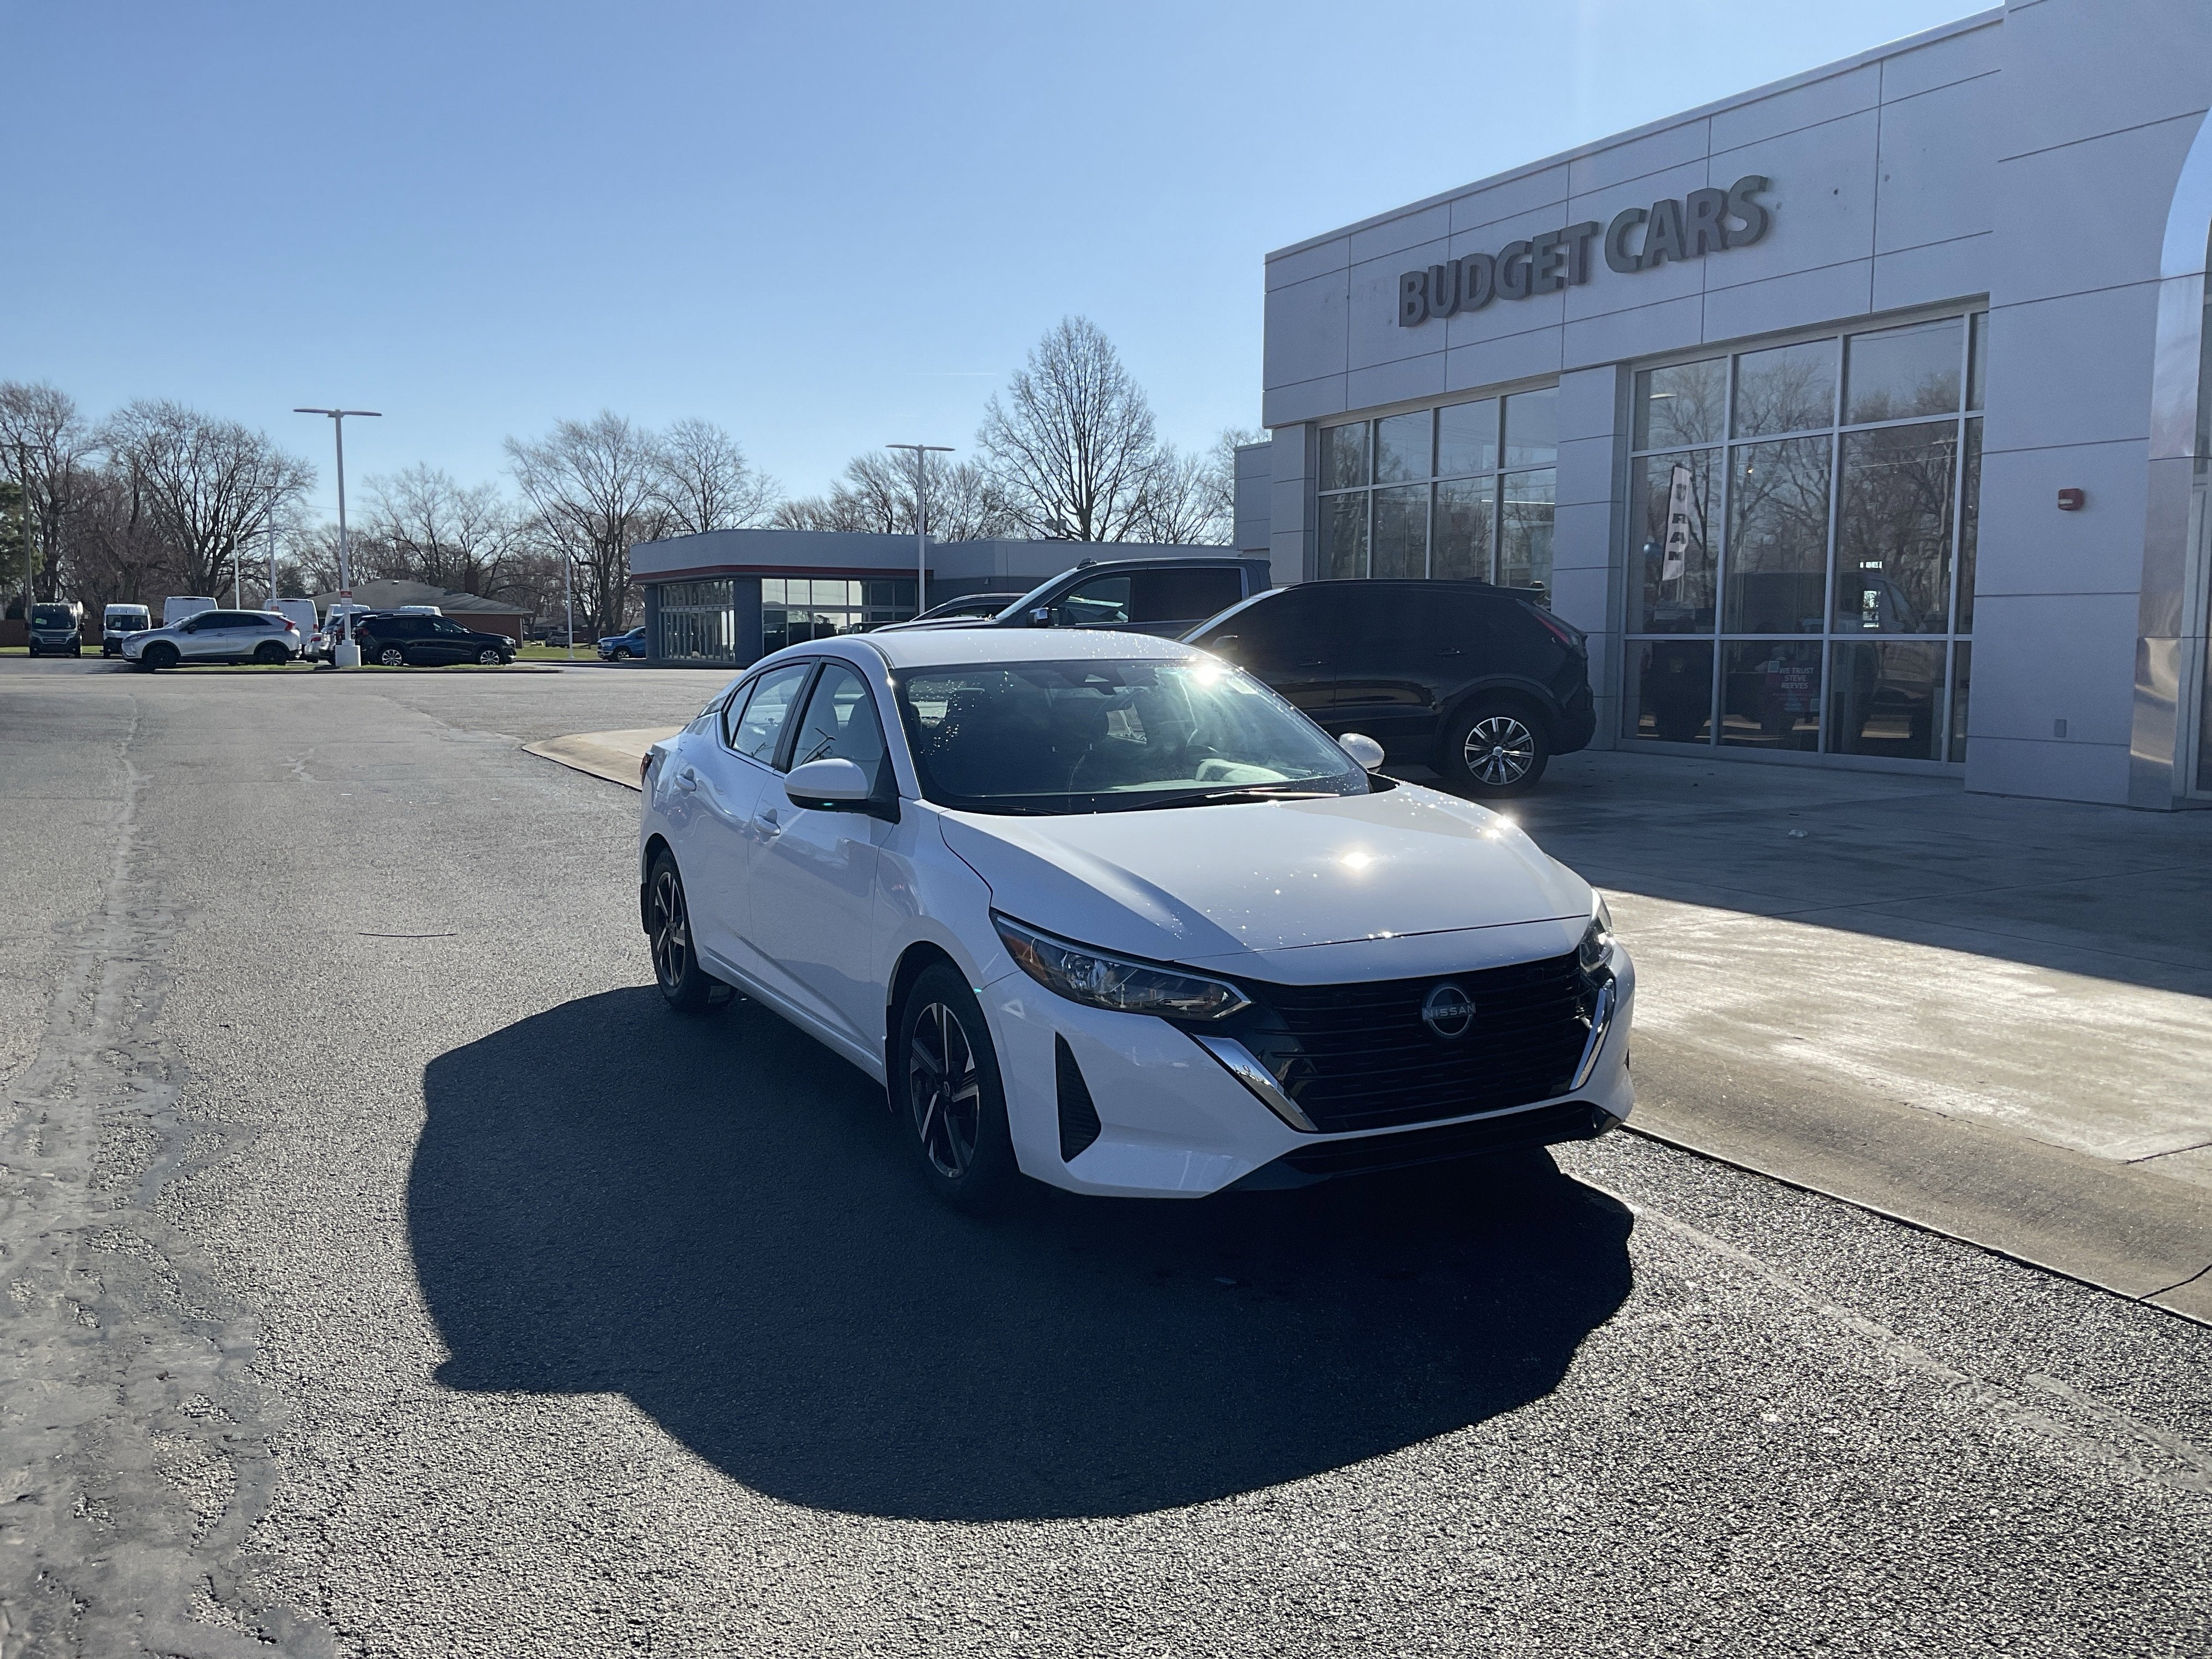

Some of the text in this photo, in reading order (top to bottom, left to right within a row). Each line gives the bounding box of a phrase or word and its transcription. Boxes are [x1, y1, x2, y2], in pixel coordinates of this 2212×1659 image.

[1399, 174, 1770, 327] BUDGET CARS
[1424, 1005, 1475, 1018] NISSAN
